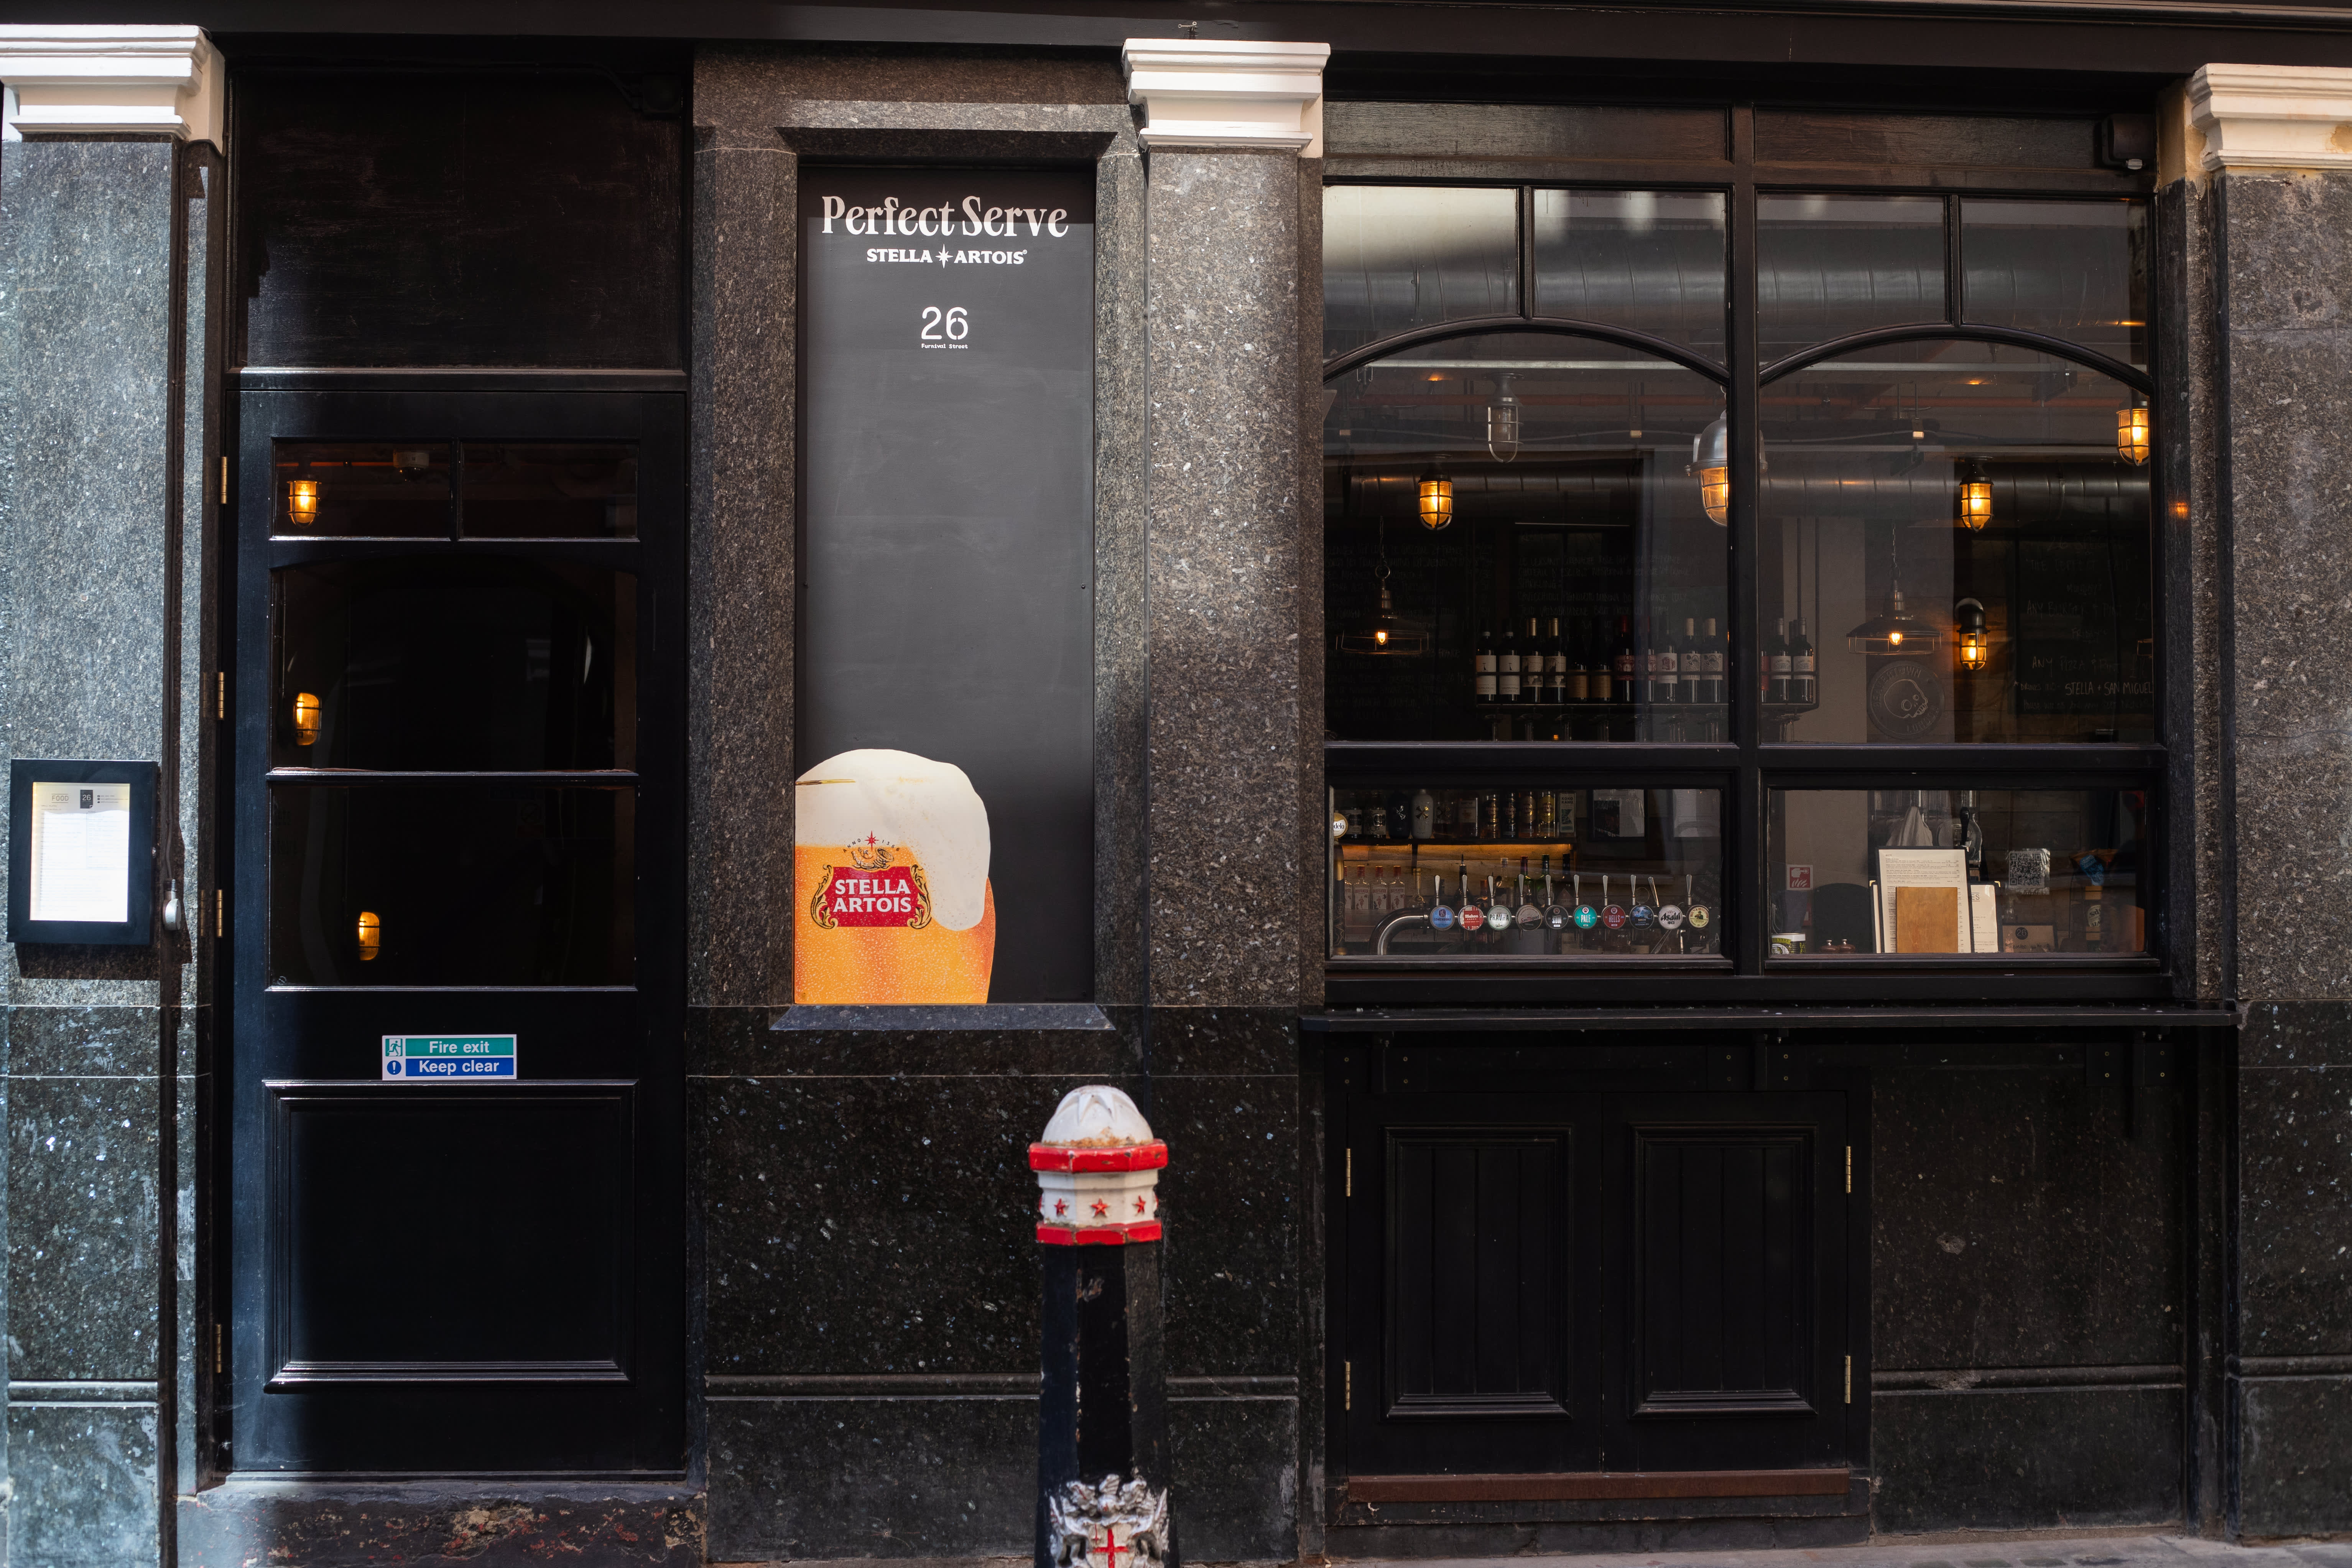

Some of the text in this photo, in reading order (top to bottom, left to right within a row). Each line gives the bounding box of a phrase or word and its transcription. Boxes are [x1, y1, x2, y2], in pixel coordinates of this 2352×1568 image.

[822, 196, 1069, 238] Perfect Serve
[867, 248, 1024, 265] STELLA ARTOIS
[921, 306, 969, 341] 26
[2065, 681, 2094, 696] STELLA
[2104, 681, 2120, 696] SAN
[2122, 681, 2153, 695] MIGUEL
[843, 838, 861, 853] ANNO
[835, 879, 911, 895] STELLA
[832, 897, 912, 913] ARTOIS
[1581, 915, 1591, 923] PALE
[1661, 912, 1681, 921] Asahi
[429, 1040, 490, 1053] Fire exit
[419, 1060, 500, 1076] Keep clear
